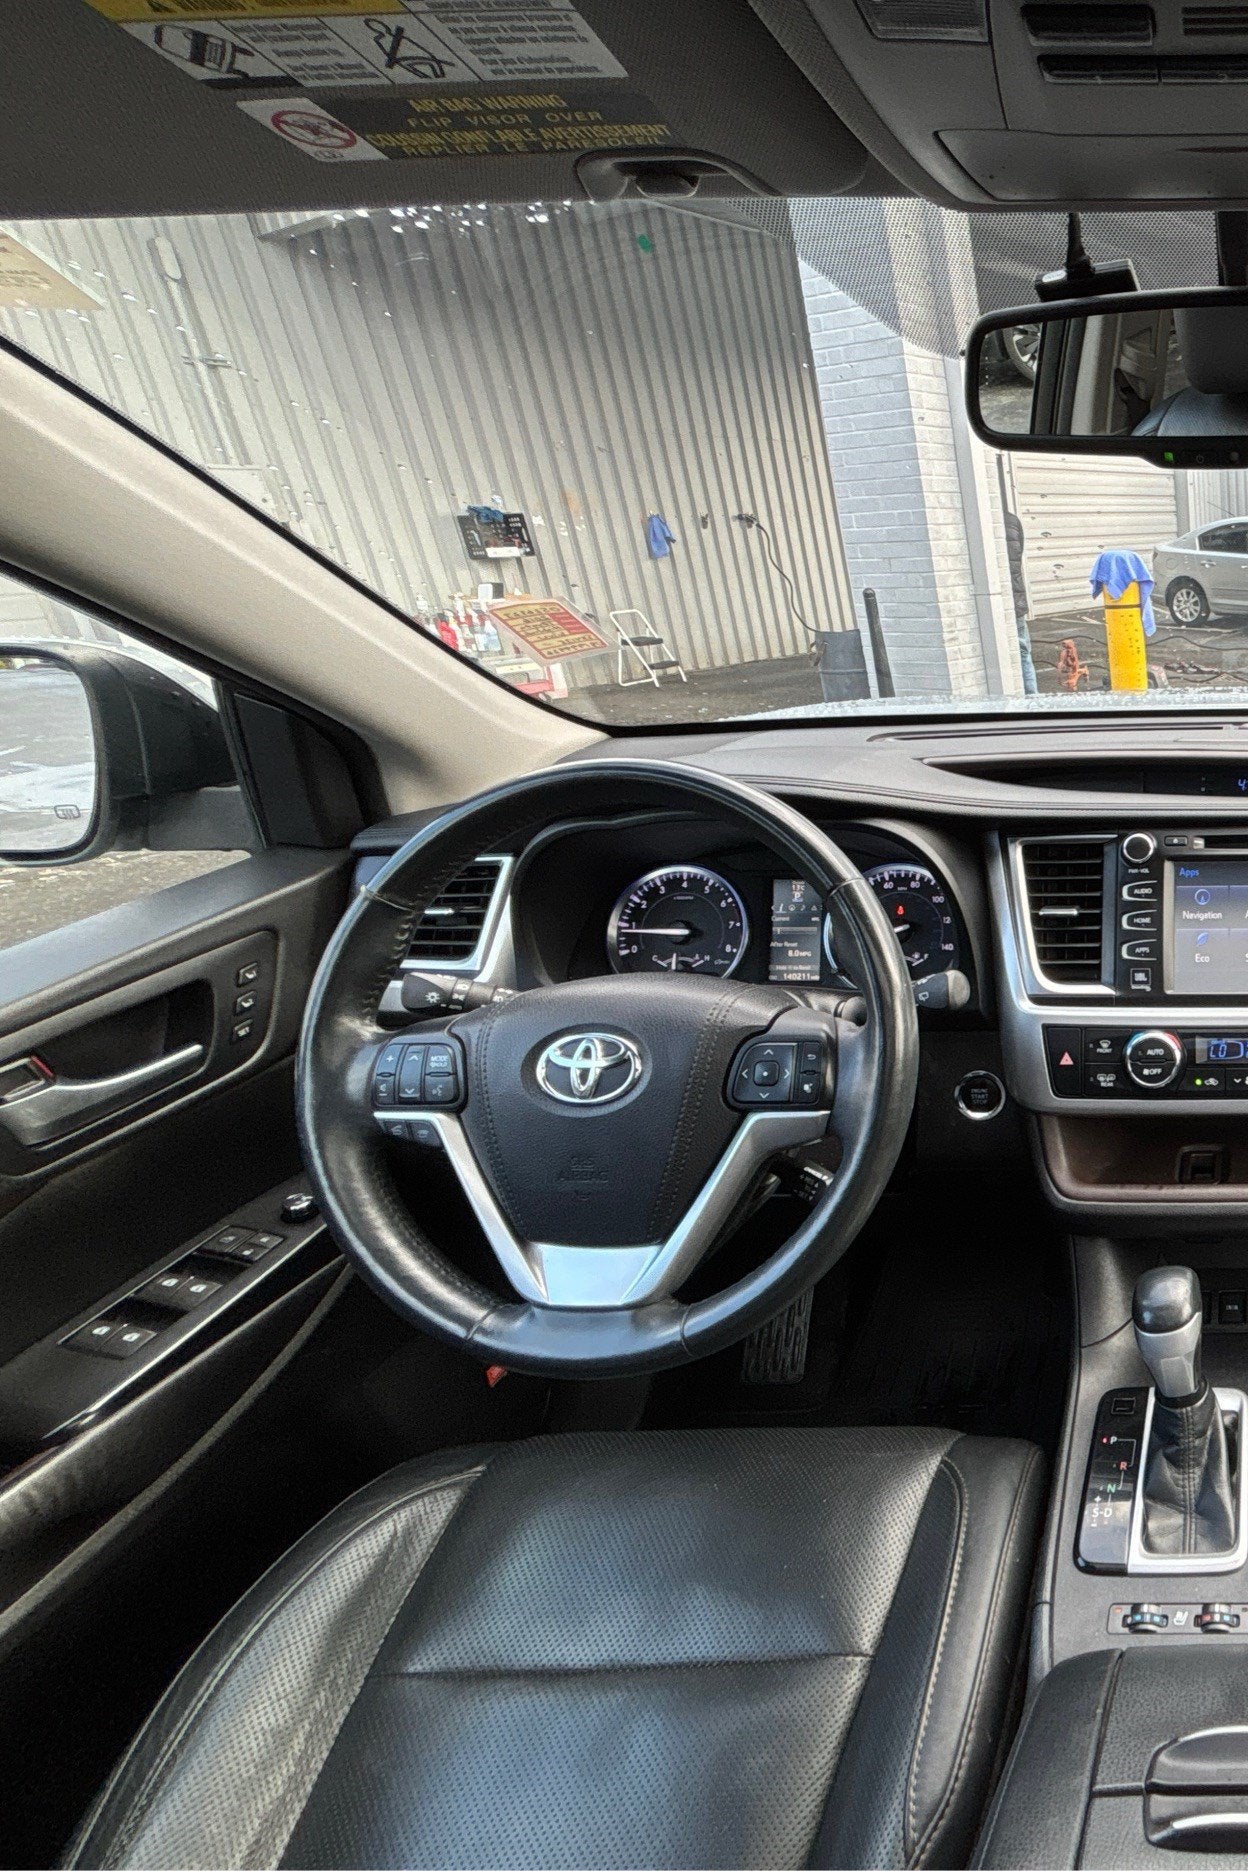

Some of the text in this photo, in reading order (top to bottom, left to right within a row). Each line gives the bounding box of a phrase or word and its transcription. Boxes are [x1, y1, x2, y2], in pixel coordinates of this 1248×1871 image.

[408, 94, 569, 113] AIR BAG WARNING
[407, 111, 602, 128] FLIP VISOR OVER
[539, 123, 672, 140] AVERTISSEMENT
[1179, 867, 1200, 877] Apps
[659, 886, 666, 894] 3
[704, 886, 710, 894] 5
[1182, 911, 1222, 920] Navigation
[728, 921, 735, 929] 7
[631, 945, 638, 953] 0
[725, 944, 731, 952] 8
[941, 943, 954, 951] 140
[1195, 954, 1210, 963] Eco
[1110, 1436, 1117, 1444] P
[1120, 1461, 1127, 1470] R
[1107, 1484, 1116, 1493] N
